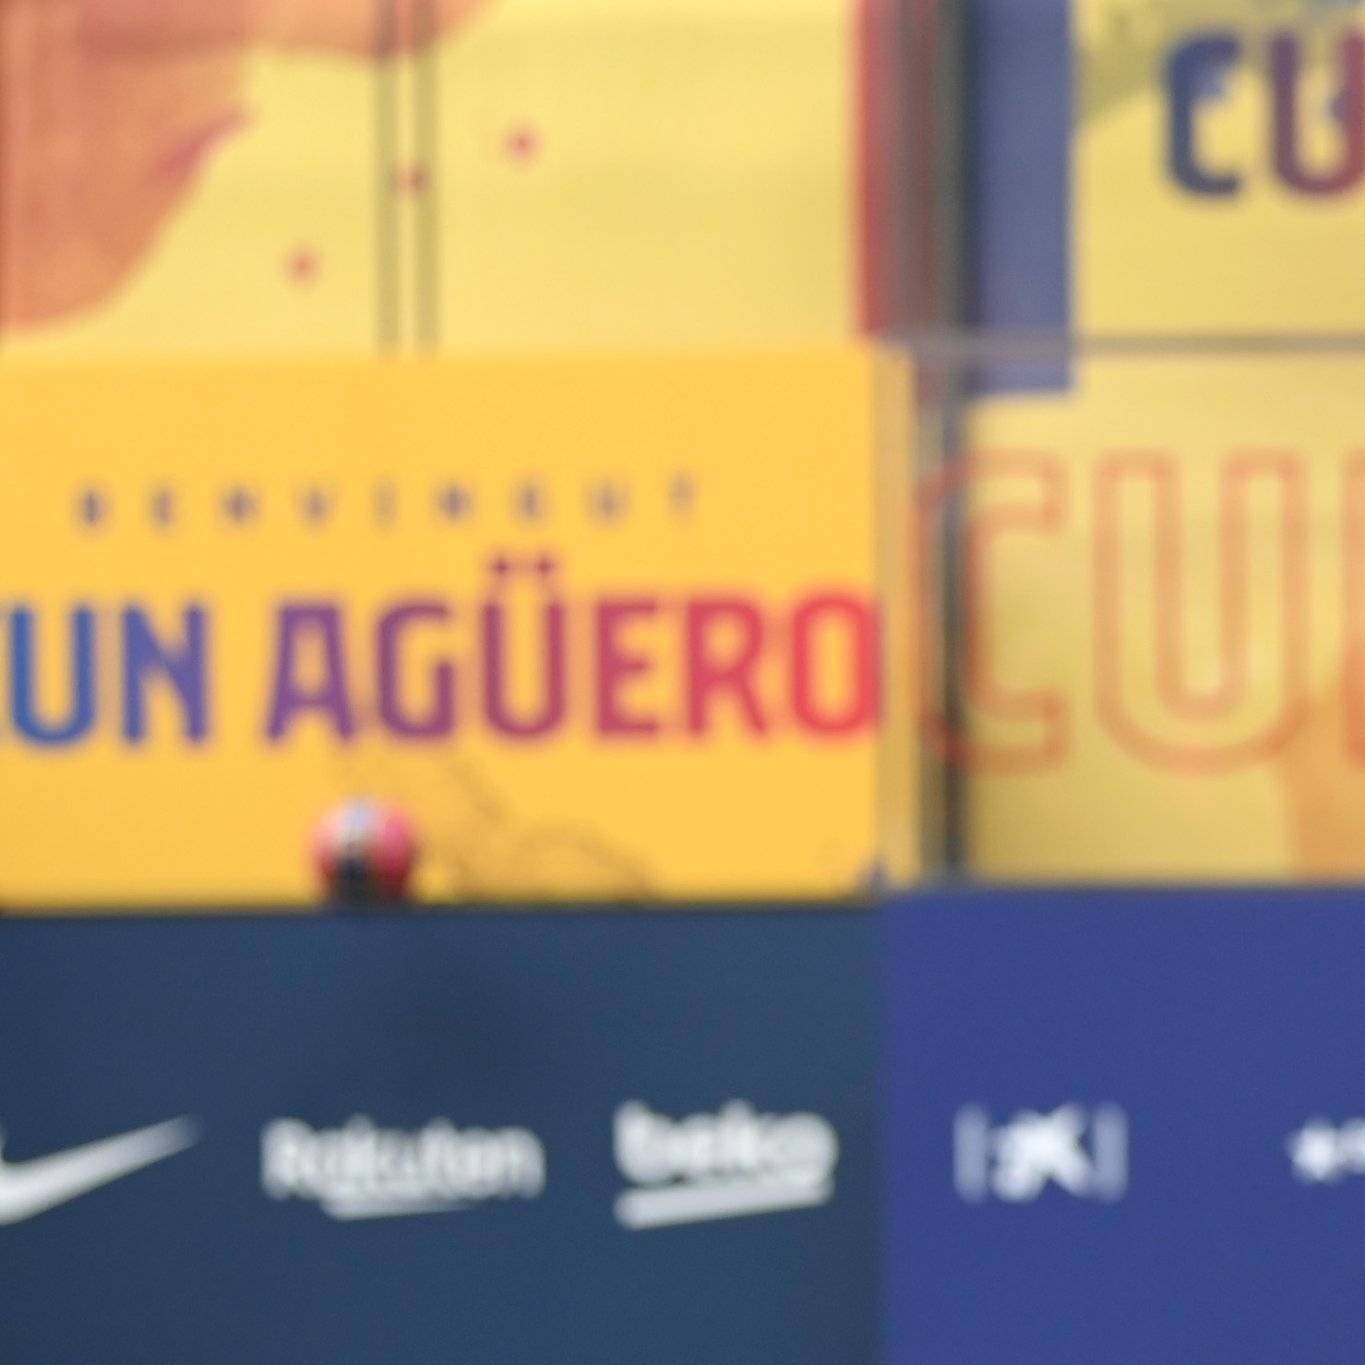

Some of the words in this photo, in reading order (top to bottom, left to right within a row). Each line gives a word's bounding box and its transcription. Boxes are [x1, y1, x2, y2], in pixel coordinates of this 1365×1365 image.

[0, 595, 208, 746] UN
[266, 548, 882, 746] AGÜERO
[260, 1114, 546, 1216] Rakuten
